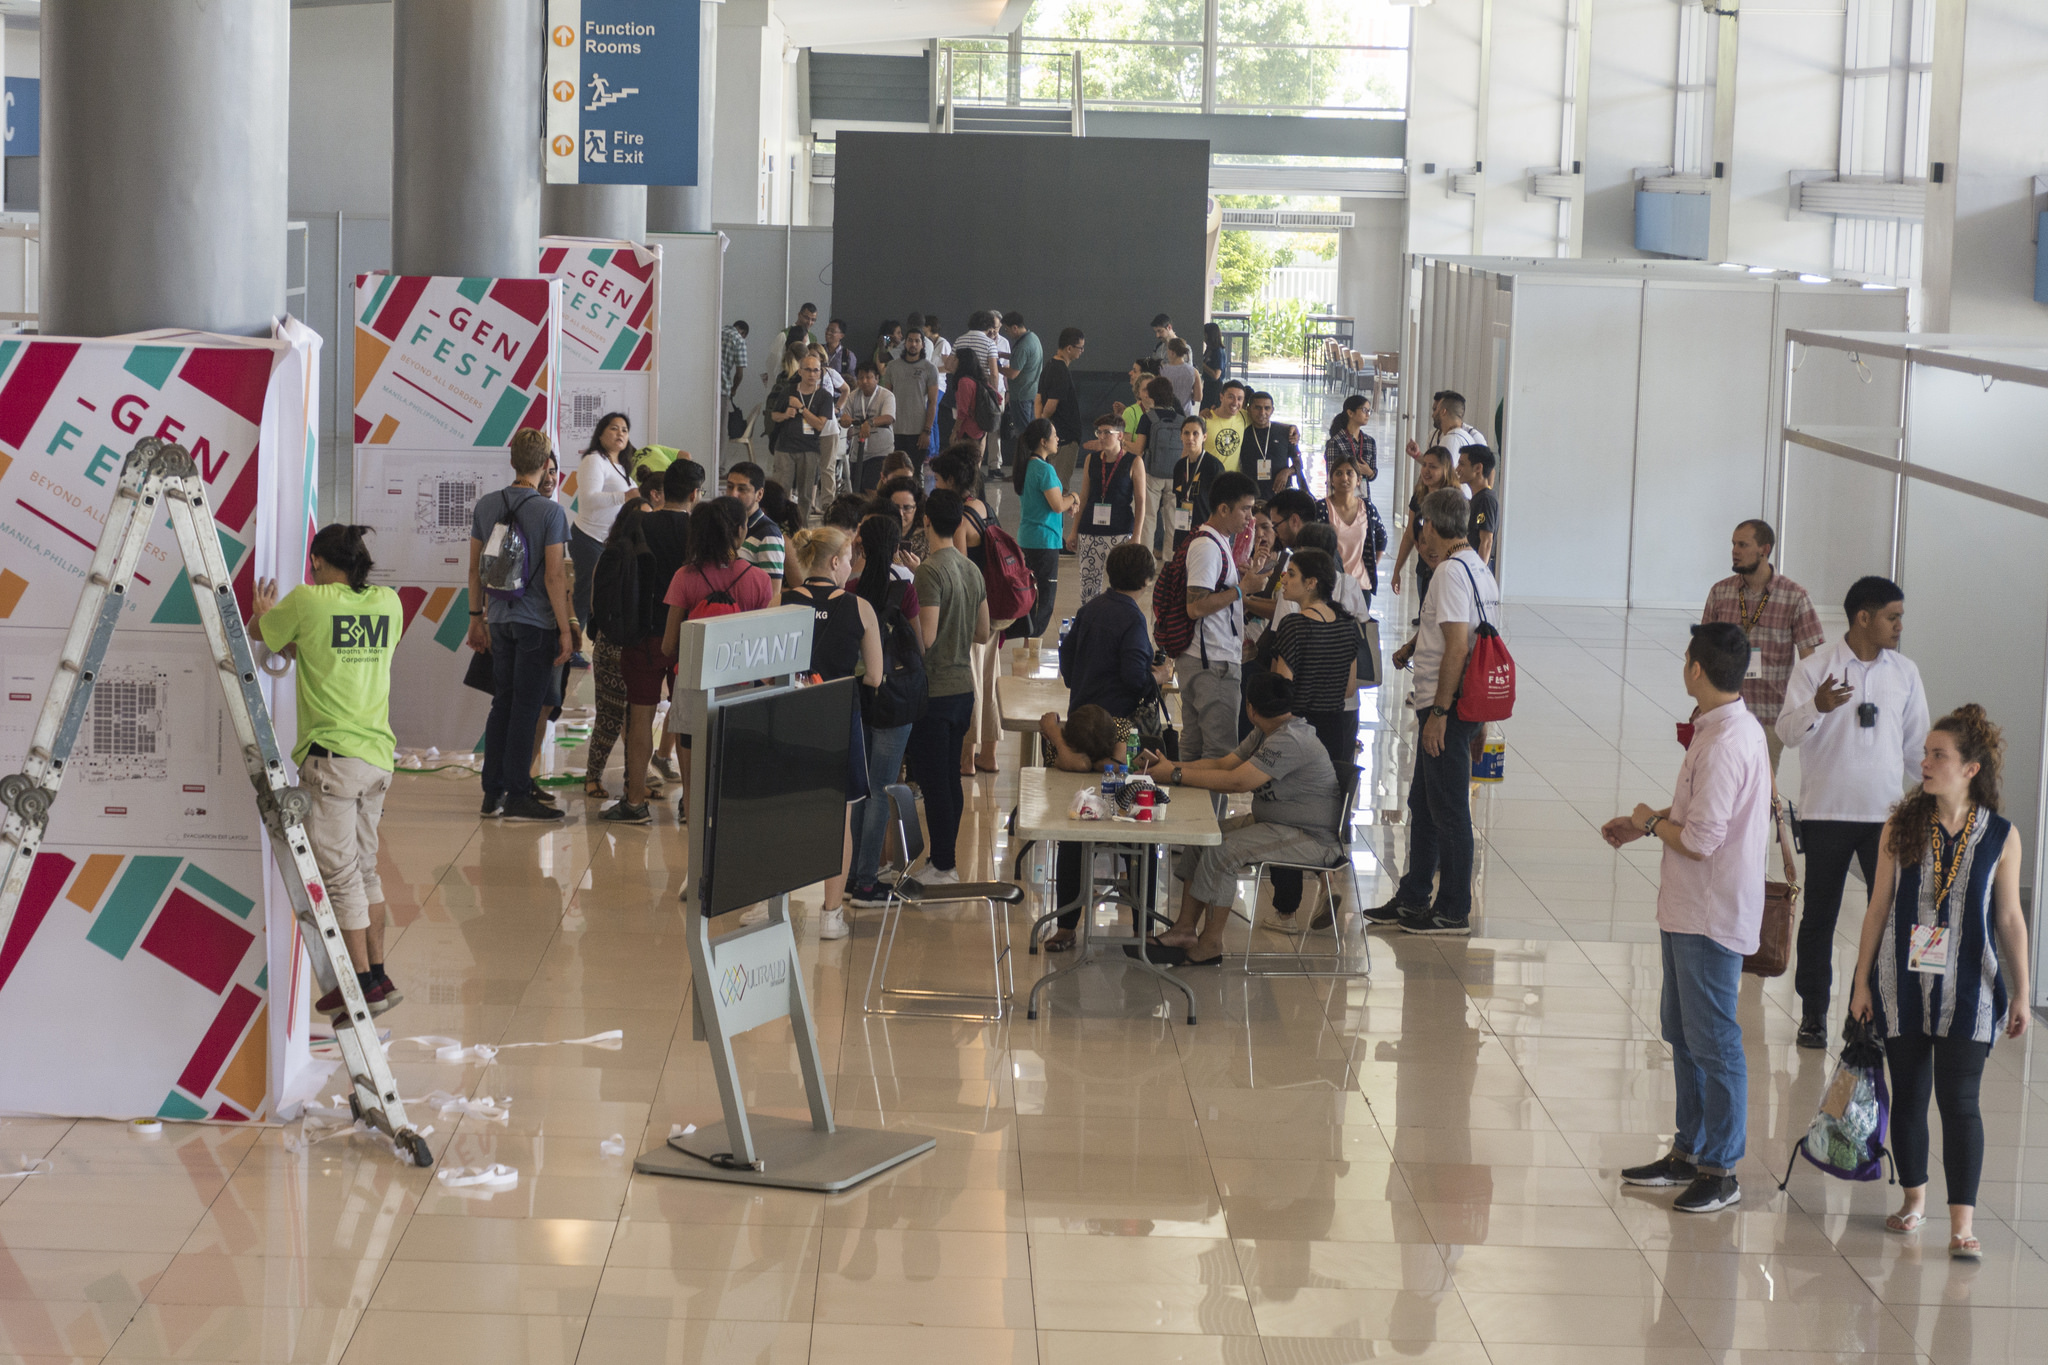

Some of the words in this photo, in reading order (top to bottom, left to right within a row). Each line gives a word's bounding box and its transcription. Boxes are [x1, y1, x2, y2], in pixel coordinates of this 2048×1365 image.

[585, 21, 655, 36] Function
[585, 39, 641, 54] Rooms
[613, 130, 644, 145] Fire
[613, 150, 644, 164] Exit
[410, 323, 502, 390] FEST
[400, 353, 432, 377] BEYOND
[432, 375, 447, 388] ALL
[448, 383, 483, 409] BORDERS
[29, 470, 82, 508] BEYOND
[83, 505, 106, 525] ALL
[222, 603, 243, 639] MSD
[337, 647, 361, 655] Booths
[341, 656, 379, 664] Corporation
[1931, 826, 1942, 873] 2018
[1946, 812, 1976, 888] GENFEST
